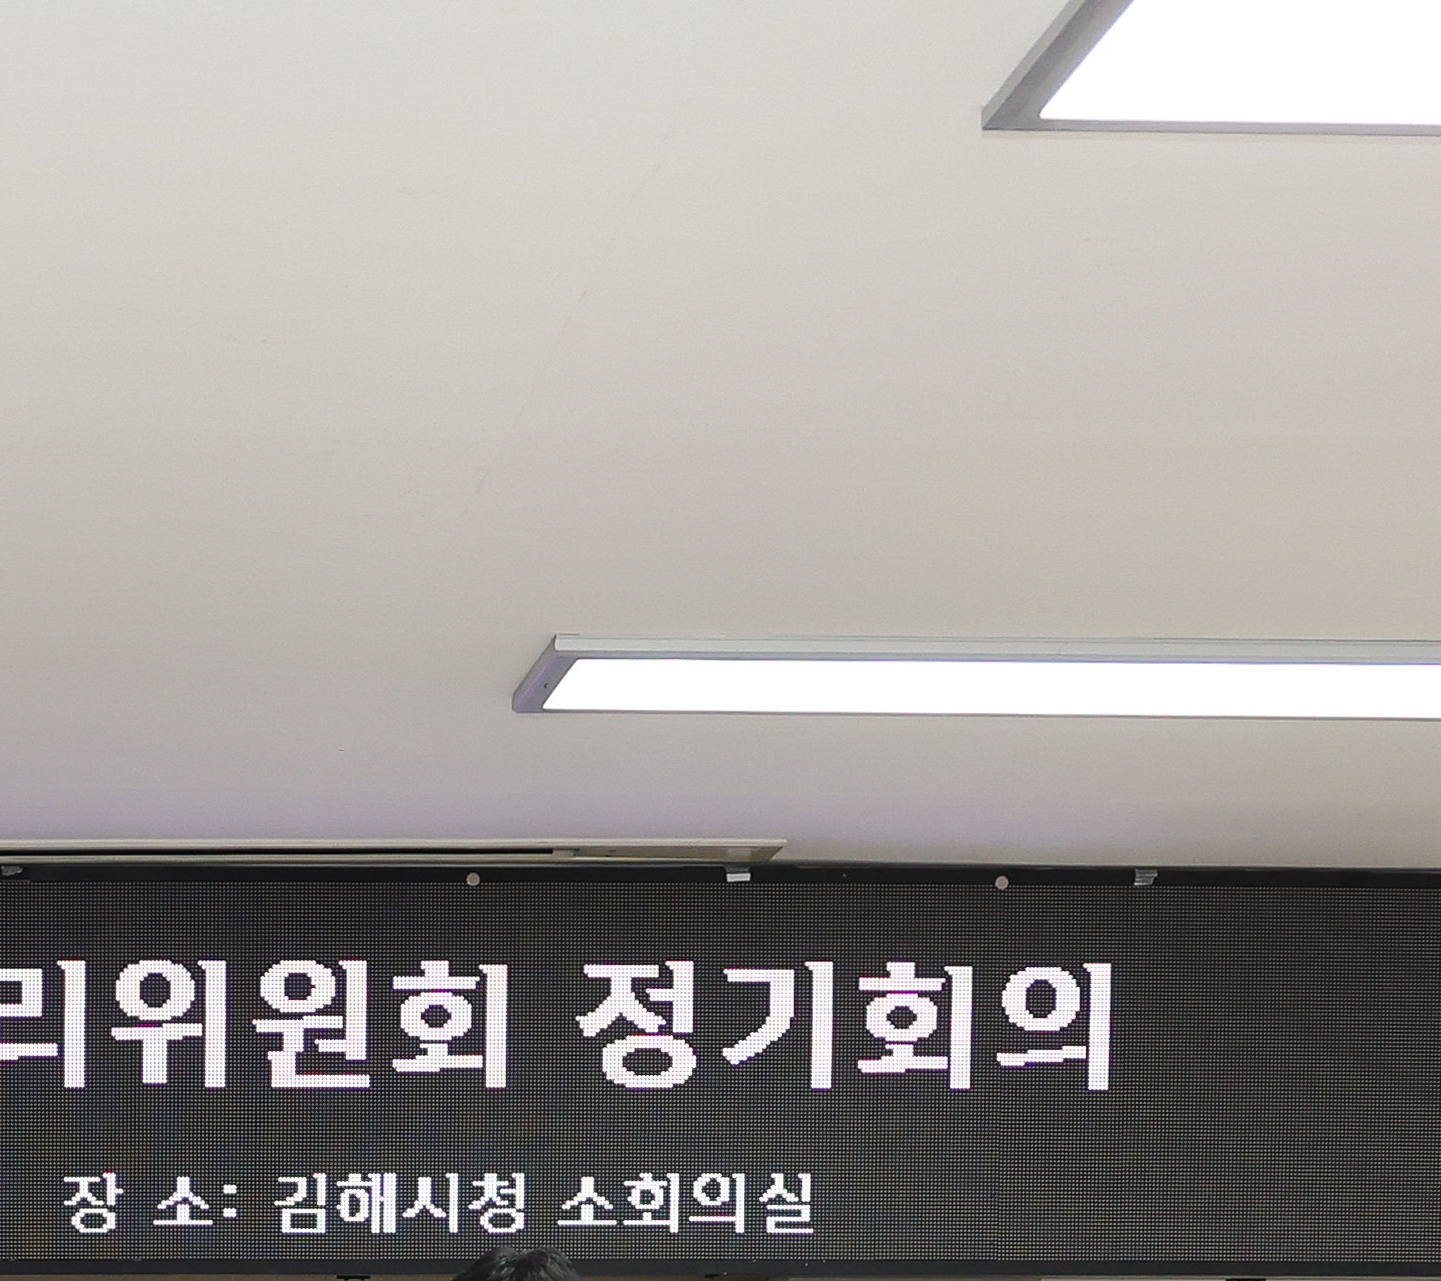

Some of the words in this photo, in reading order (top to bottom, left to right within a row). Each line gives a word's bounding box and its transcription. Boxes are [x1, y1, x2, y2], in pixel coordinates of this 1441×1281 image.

[576, 960, 1114, 1093] 정기회의
[274, 1172, 527, 1236] 김해시청
[558, 1172, 815, 1236] 소회의실
